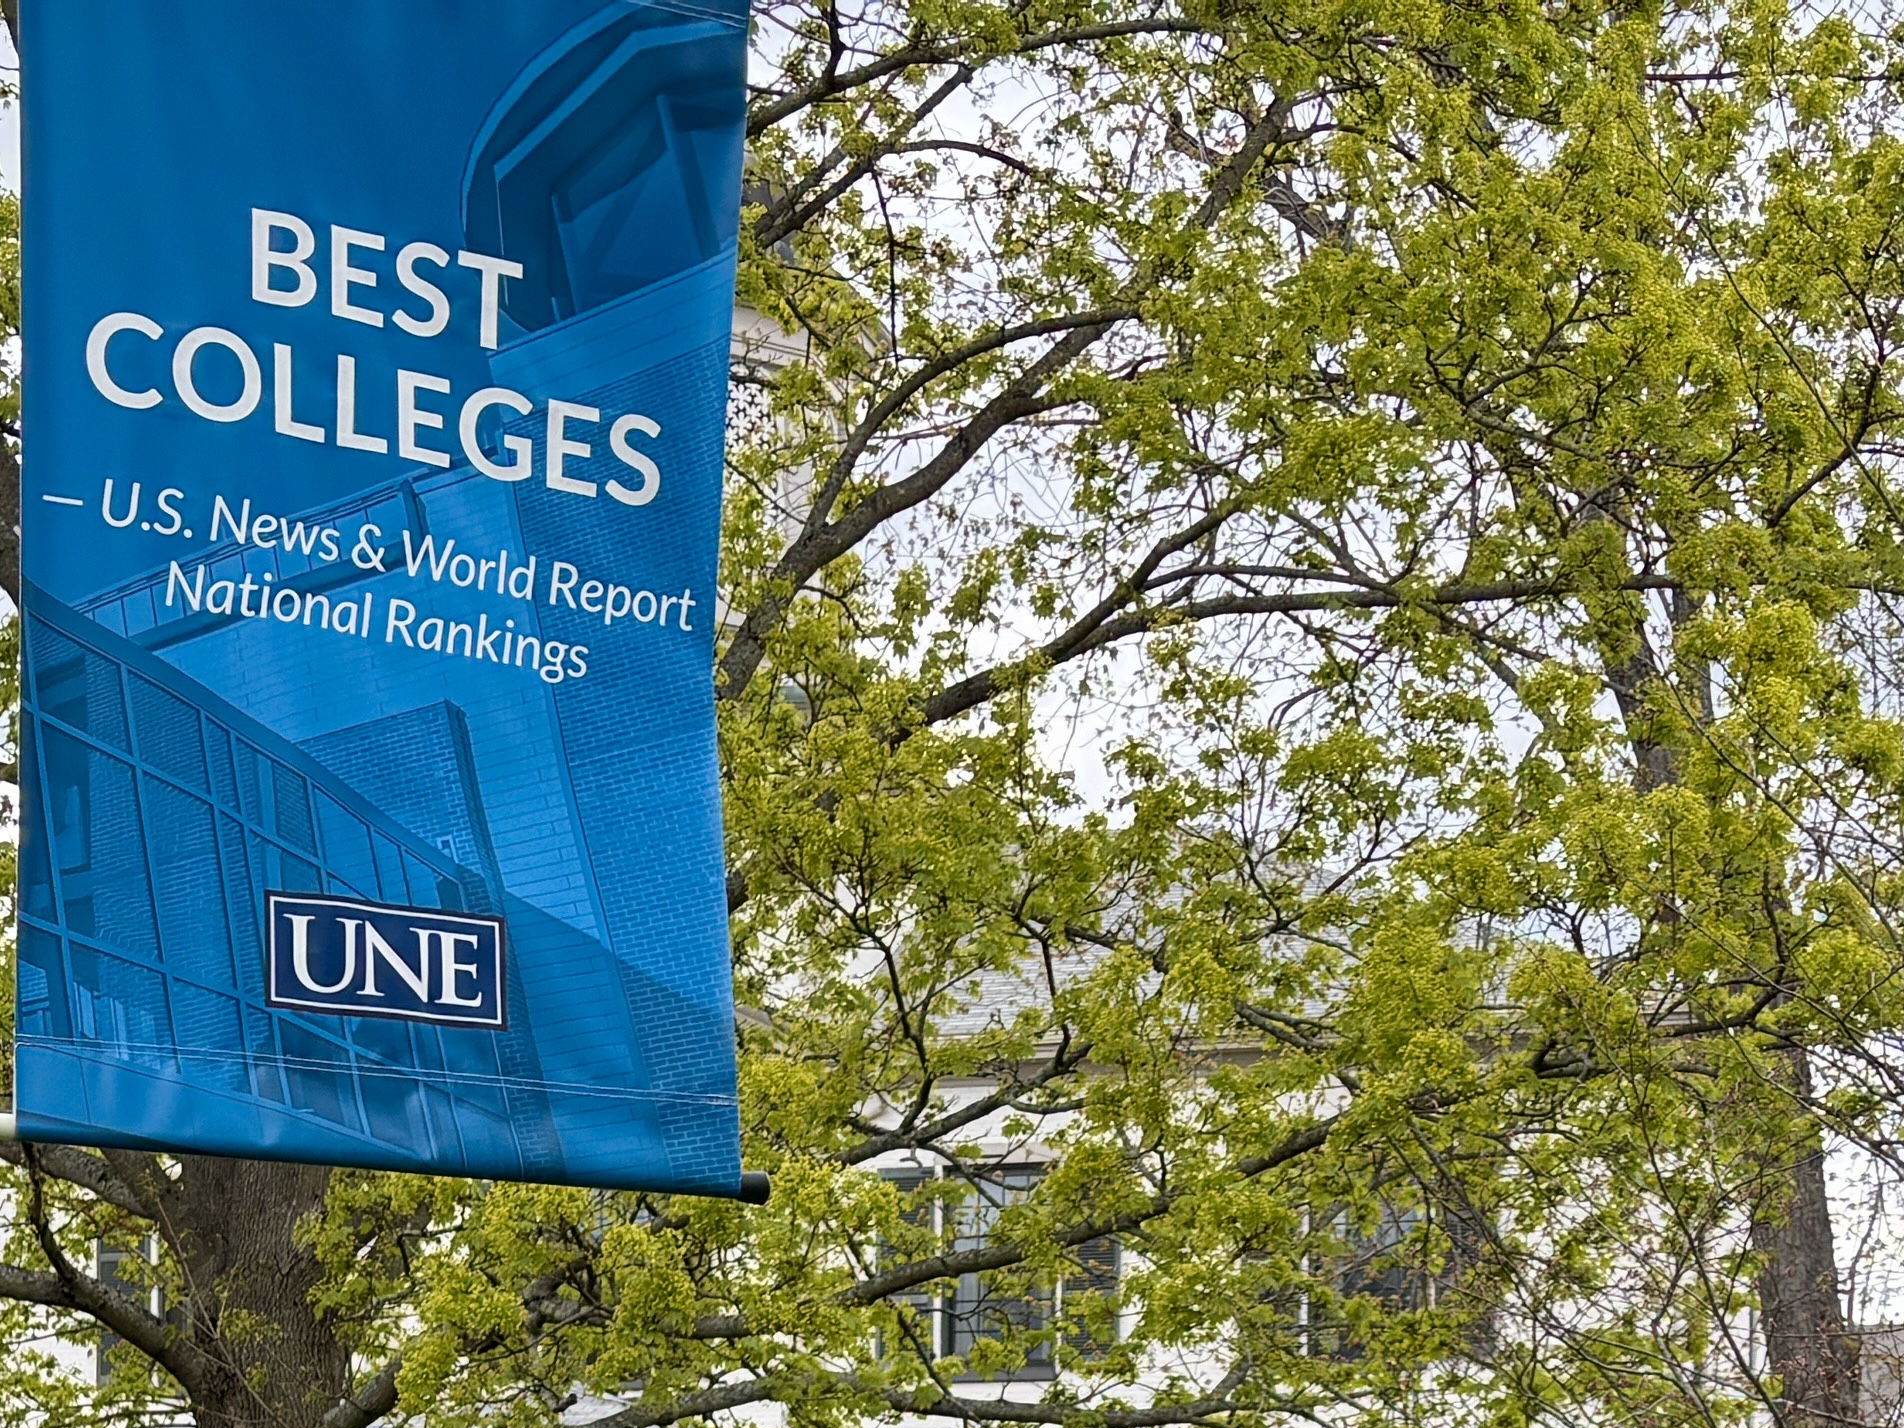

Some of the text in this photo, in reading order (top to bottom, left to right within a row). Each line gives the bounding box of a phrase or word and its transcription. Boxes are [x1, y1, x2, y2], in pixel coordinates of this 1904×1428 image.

[251, 207, 523, 350] BEST
[85, 312, 662, 506] COLLEGES
[101, 478, 194, 540] U.S.
[210, 495, 341, 562] News
[351, 523, 388, 573] &
[402, 529, 537, 602] World
[549, 561, 697, 633] Report
[166, 560, 591, 684] National Rankings
[282, 912, 483, 1008] UNE
